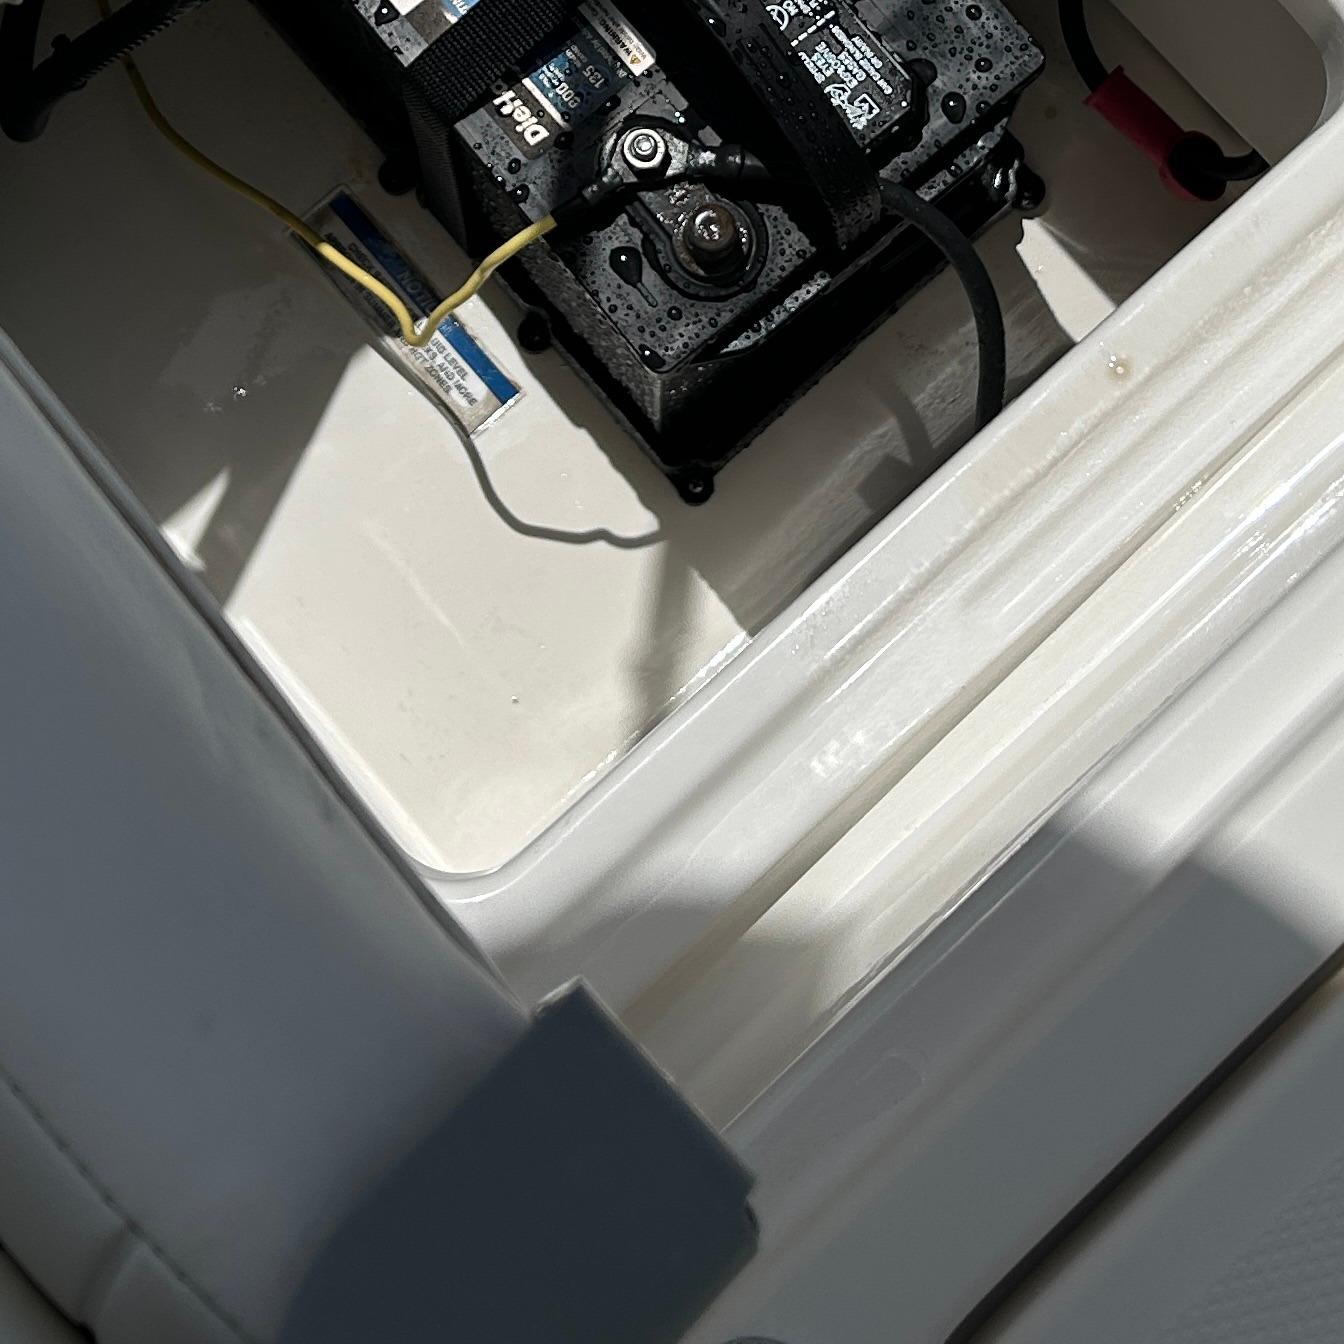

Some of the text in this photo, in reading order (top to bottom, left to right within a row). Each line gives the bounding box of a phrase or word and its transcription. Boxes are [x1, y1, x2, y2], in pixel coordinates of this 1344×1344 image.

[438, 362, 454, 379] AND
[453, 380, 475, 404] MORE
[445, 354, 468, 379] LEVEL
